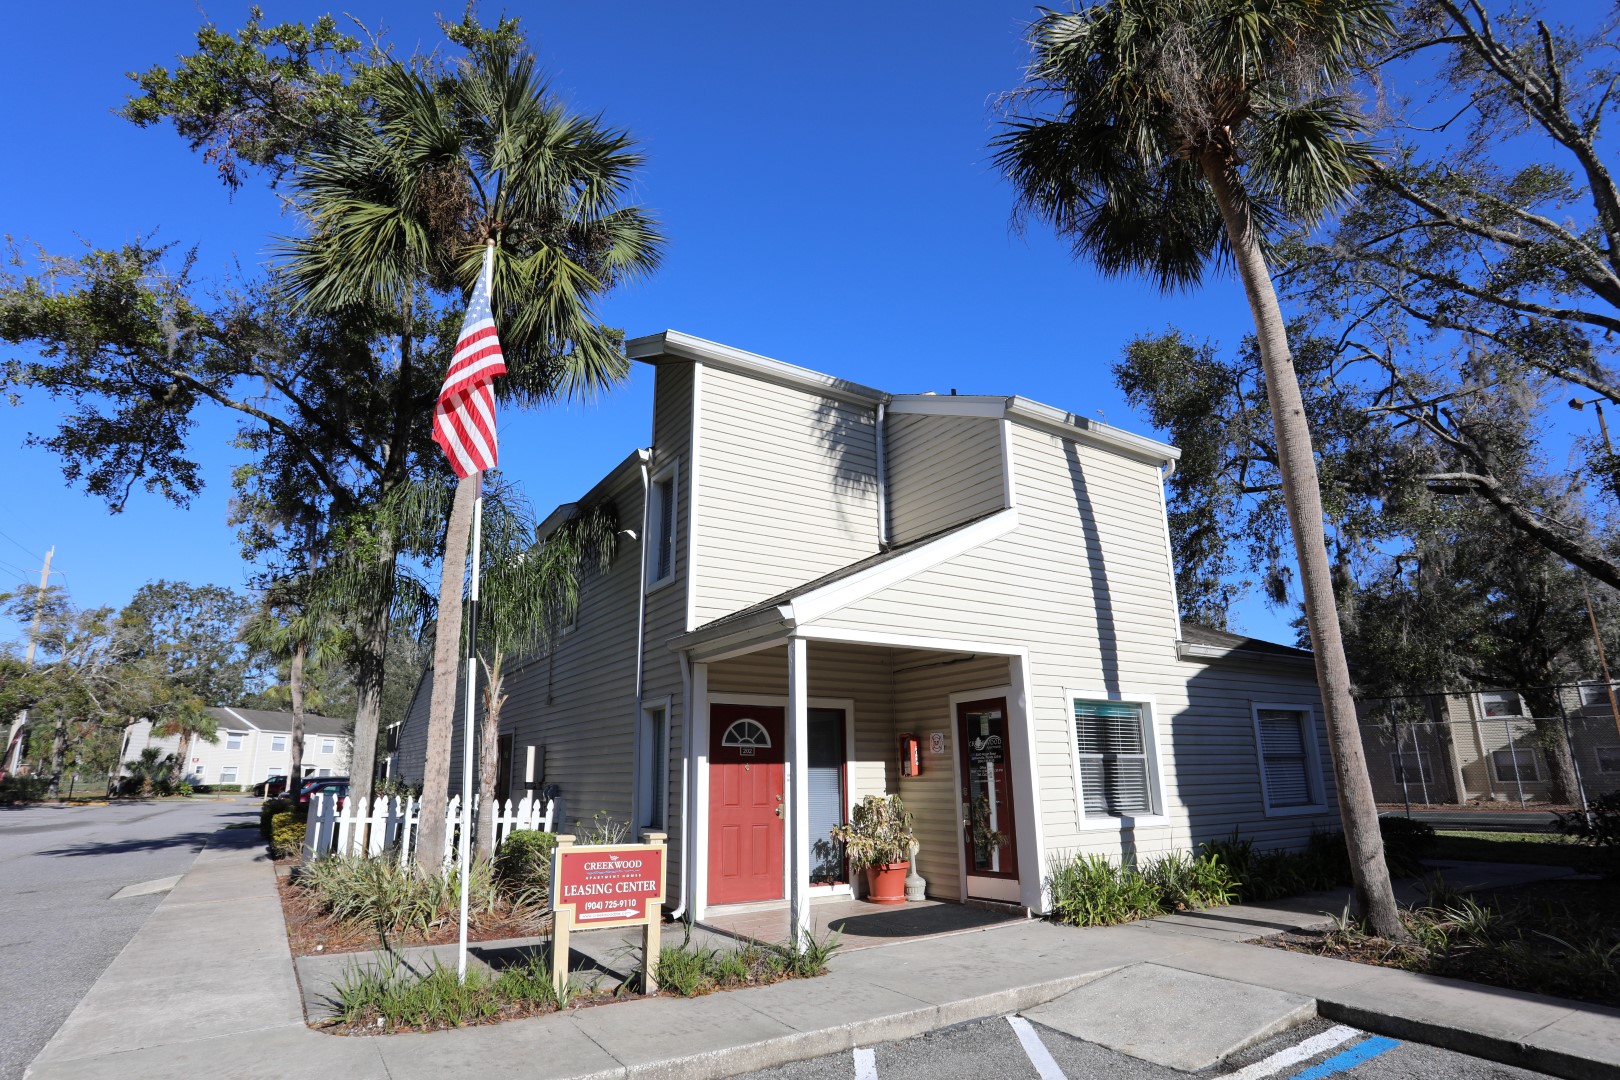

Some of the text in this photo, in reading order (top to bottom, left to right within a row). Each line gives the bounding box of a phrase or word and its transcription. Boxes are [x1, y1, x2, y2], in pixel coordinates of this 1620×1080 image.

[584, 860, 642, 871] CREEKWOOD
[564, 880, 656, 896] LEASING CENTER
[584, 898, 636, 910] (904) 725-9110
